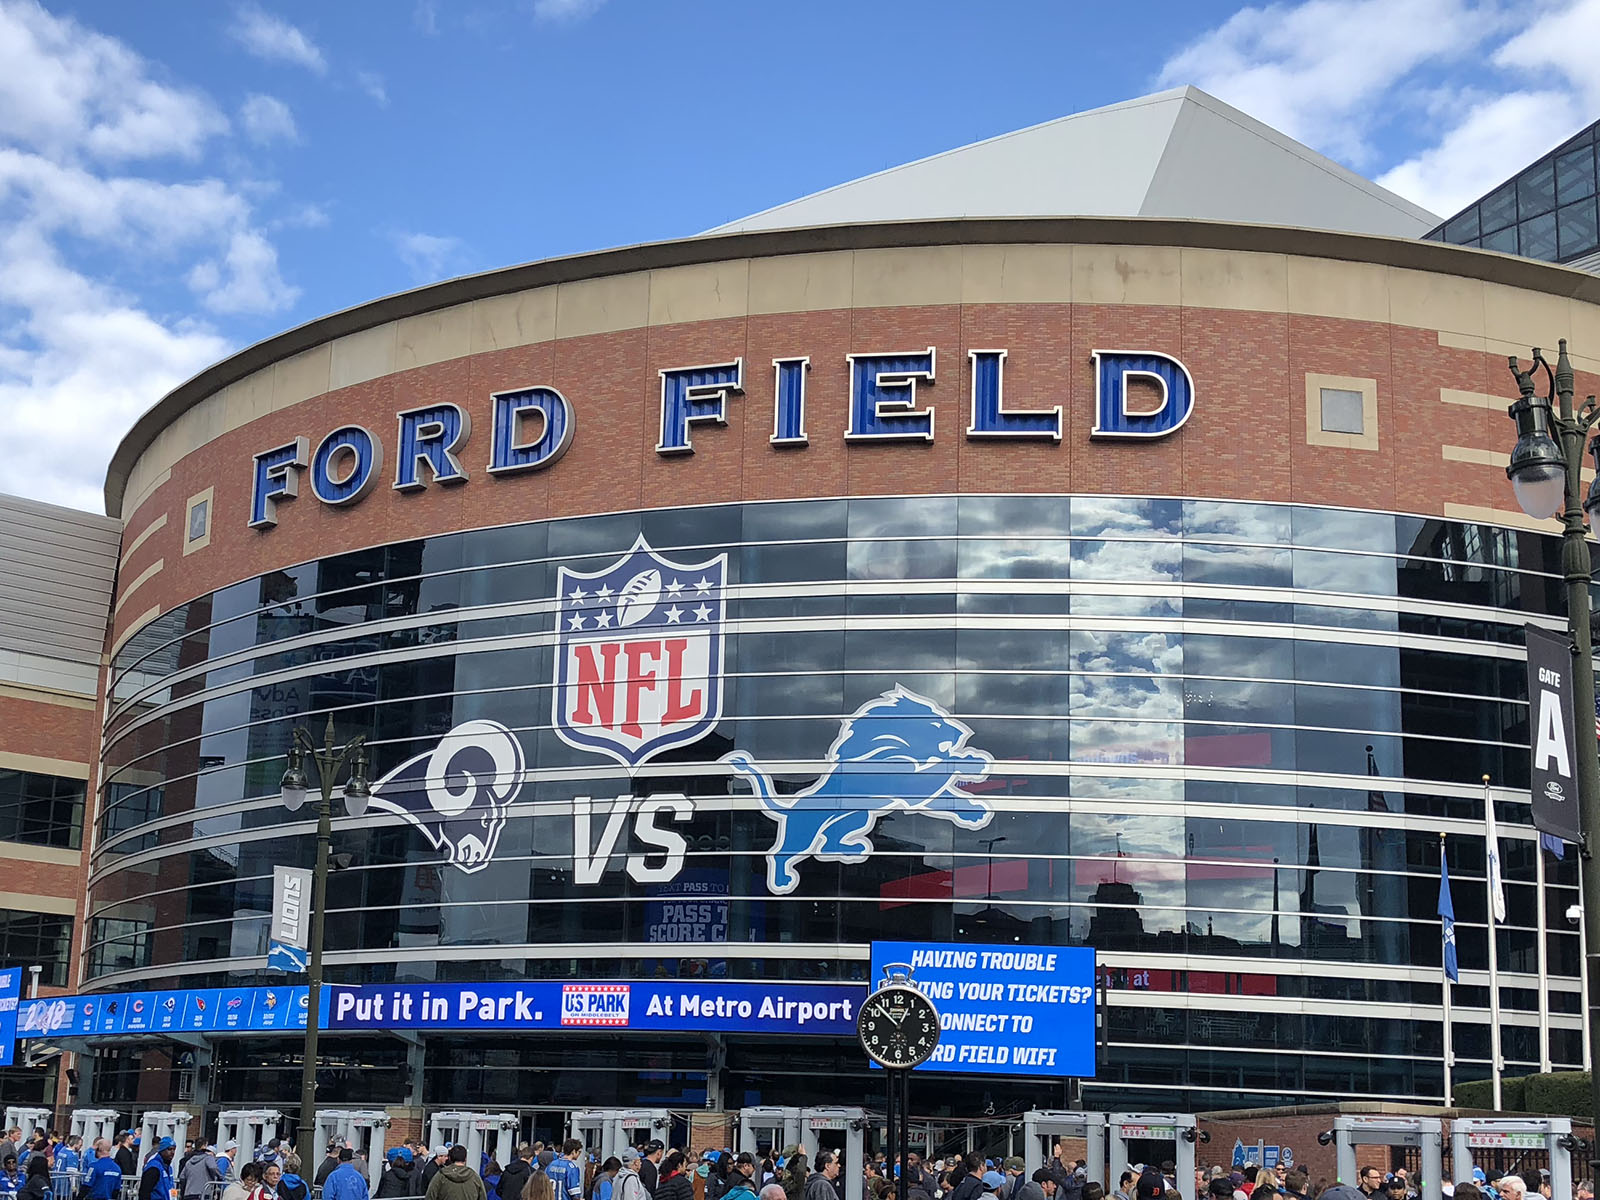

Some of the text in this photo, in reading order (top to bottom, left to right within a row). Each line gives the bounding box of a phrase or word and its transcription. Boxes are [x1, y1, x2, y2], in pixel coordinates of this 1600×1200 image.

[248, 346, 1197, 530] FORD FIELD
[1538, 666, 1561, 688] GATE
[572, 638, 702, 739] NFL
[1535, 690, 1571, 778] A
[574, 793, 695, 884] VS
[683, 882, 708, 892] PASS
[710, 883, 725, 892] TO
[281, 874, 301, 940] LIONS
[662, 905, 712, 924] PASS
[650, 924, 706, 942] SCORE
[911, 950, 1057, 971] HAVING TROUBLE
[1133, 970, 1150, 986] at
[893, 995, 904, 1004] 12
[918, 981, 1092, 1004] ING YOUR TICKETS?
[337, 993, 383, 1020] Put
[392, 992, 412, 1020] it
[421, 992, 448, 1020] in
[458, 991, 543, 1020] Park.
[588, 993, 626, 1012] PARK
[646, 994, 852, 1024] At Metro Airport
[881, 998, 889, 1007] 11
[910, 999, 915, 1008] 1
[870, 1008, 881, 1017] 10
[918, 1009, 926, 1019] 2
[868, 1021, 875, 1031] 9
[922, 1023, 929, 1033] 3
[939, 1013, 1033, 1033] ONNECT TO
[871, 1035, 879, 1045] 8
[918, 1036, 926, 1046] 4
[881, 1046, 888, 1055] 7
[895, 1049, 902, 1059] 6
[908, 1046, 916, 1056] 5
[926, 1044, 1057, 1066] RD FIELD WIFI
